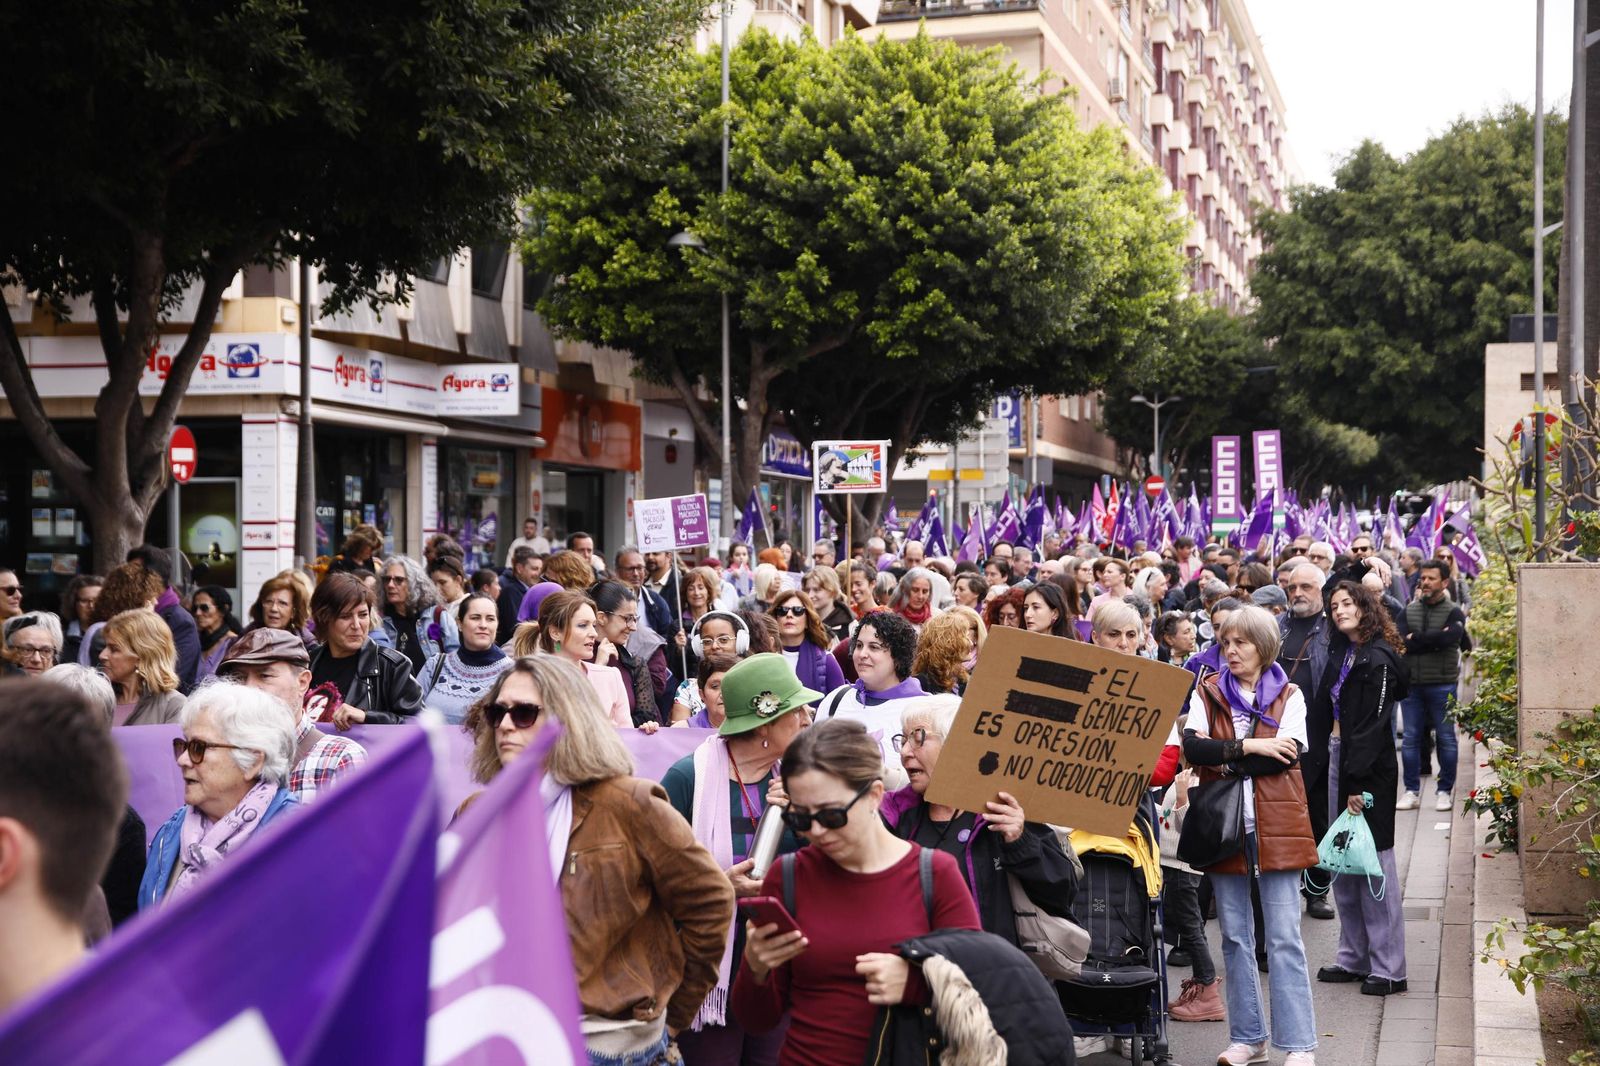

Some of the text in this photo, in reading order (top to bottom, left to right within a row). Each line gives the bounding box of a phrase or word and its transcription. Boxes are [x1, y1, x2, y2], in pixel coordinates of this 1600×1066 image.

[1217, 441, 1235, 514] CCOO
[1106, 668, 1146, 702] EL
[973, 711, 1117, 766] ES OPRESIÓN,
[1082, 697, 1161, 740] GÉNERO
[1003, 755, 1152, 808] NO COEDUCACIÓN
